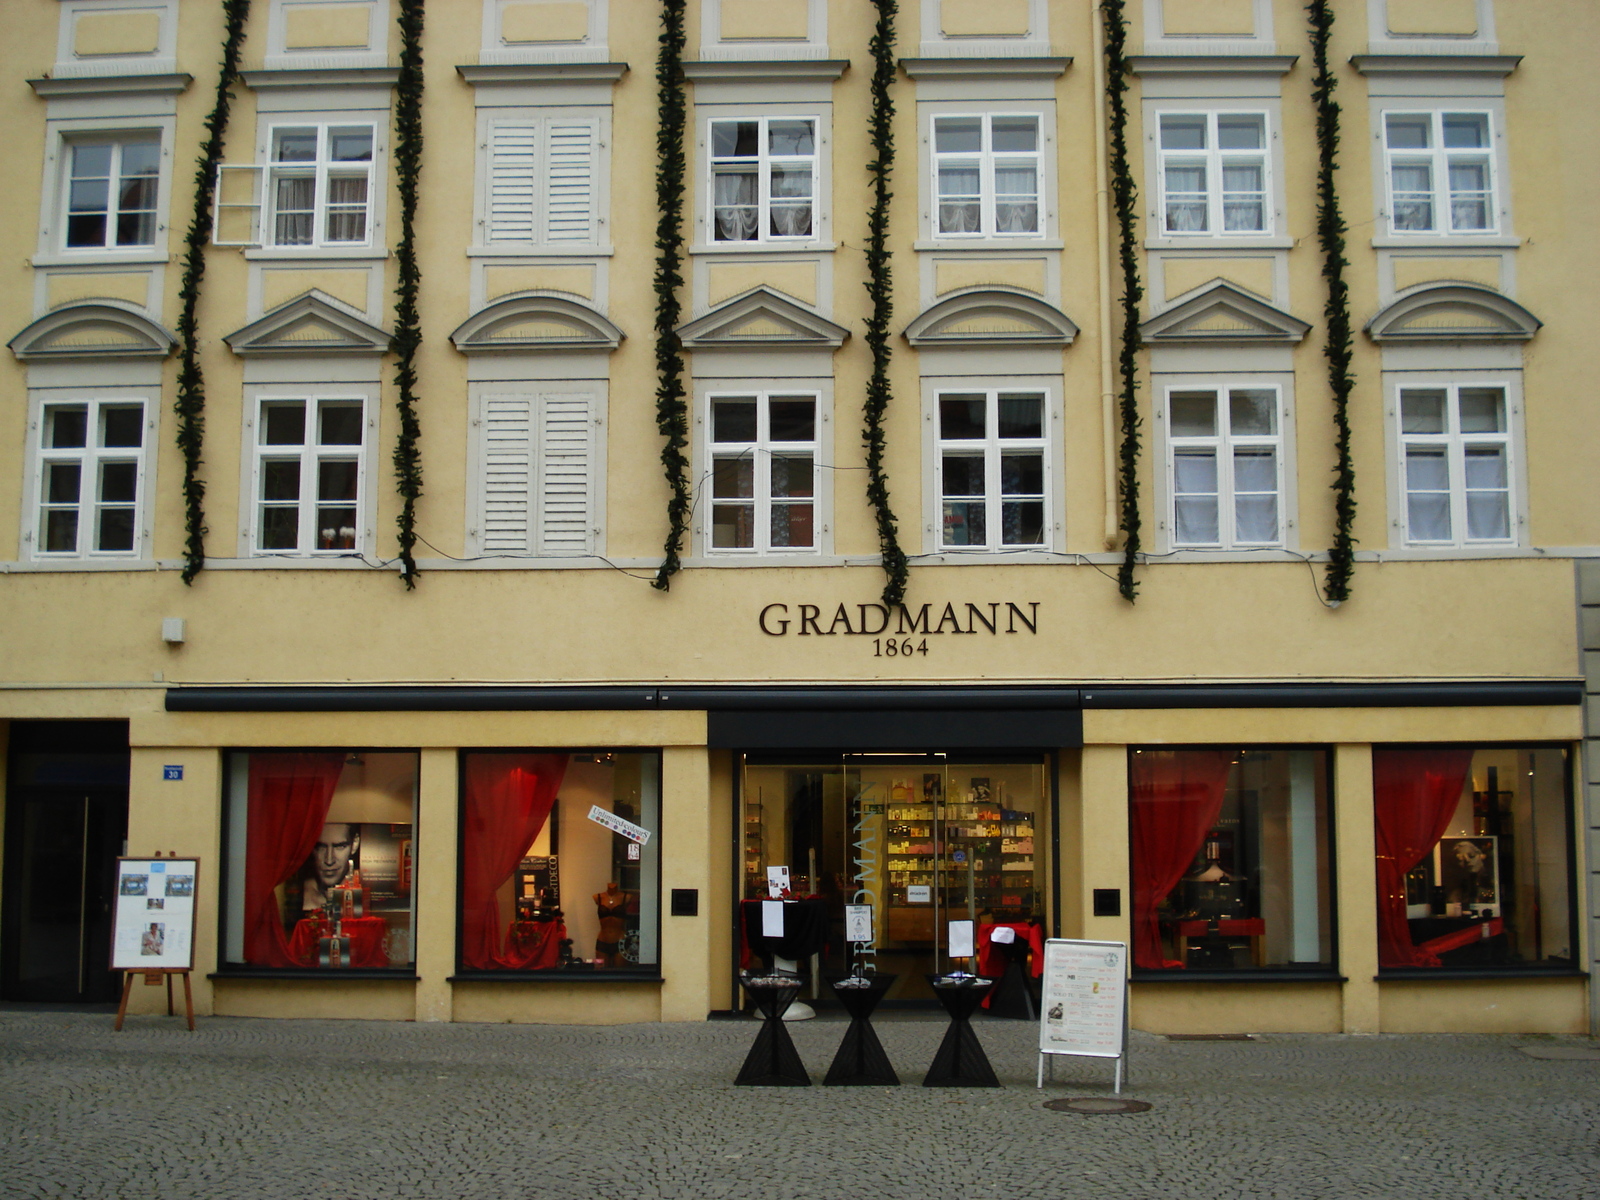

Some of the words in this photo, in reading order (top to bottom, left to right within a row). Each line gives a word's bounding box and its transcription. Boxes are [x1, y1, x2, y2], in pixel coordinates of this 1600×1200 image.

[759, 602, 1041, 636] GRADMANN
[873, 638, 929, 657] 1864
[169, 770, 179, 779] 30
[852, 781, 877, 977] RDMANN
